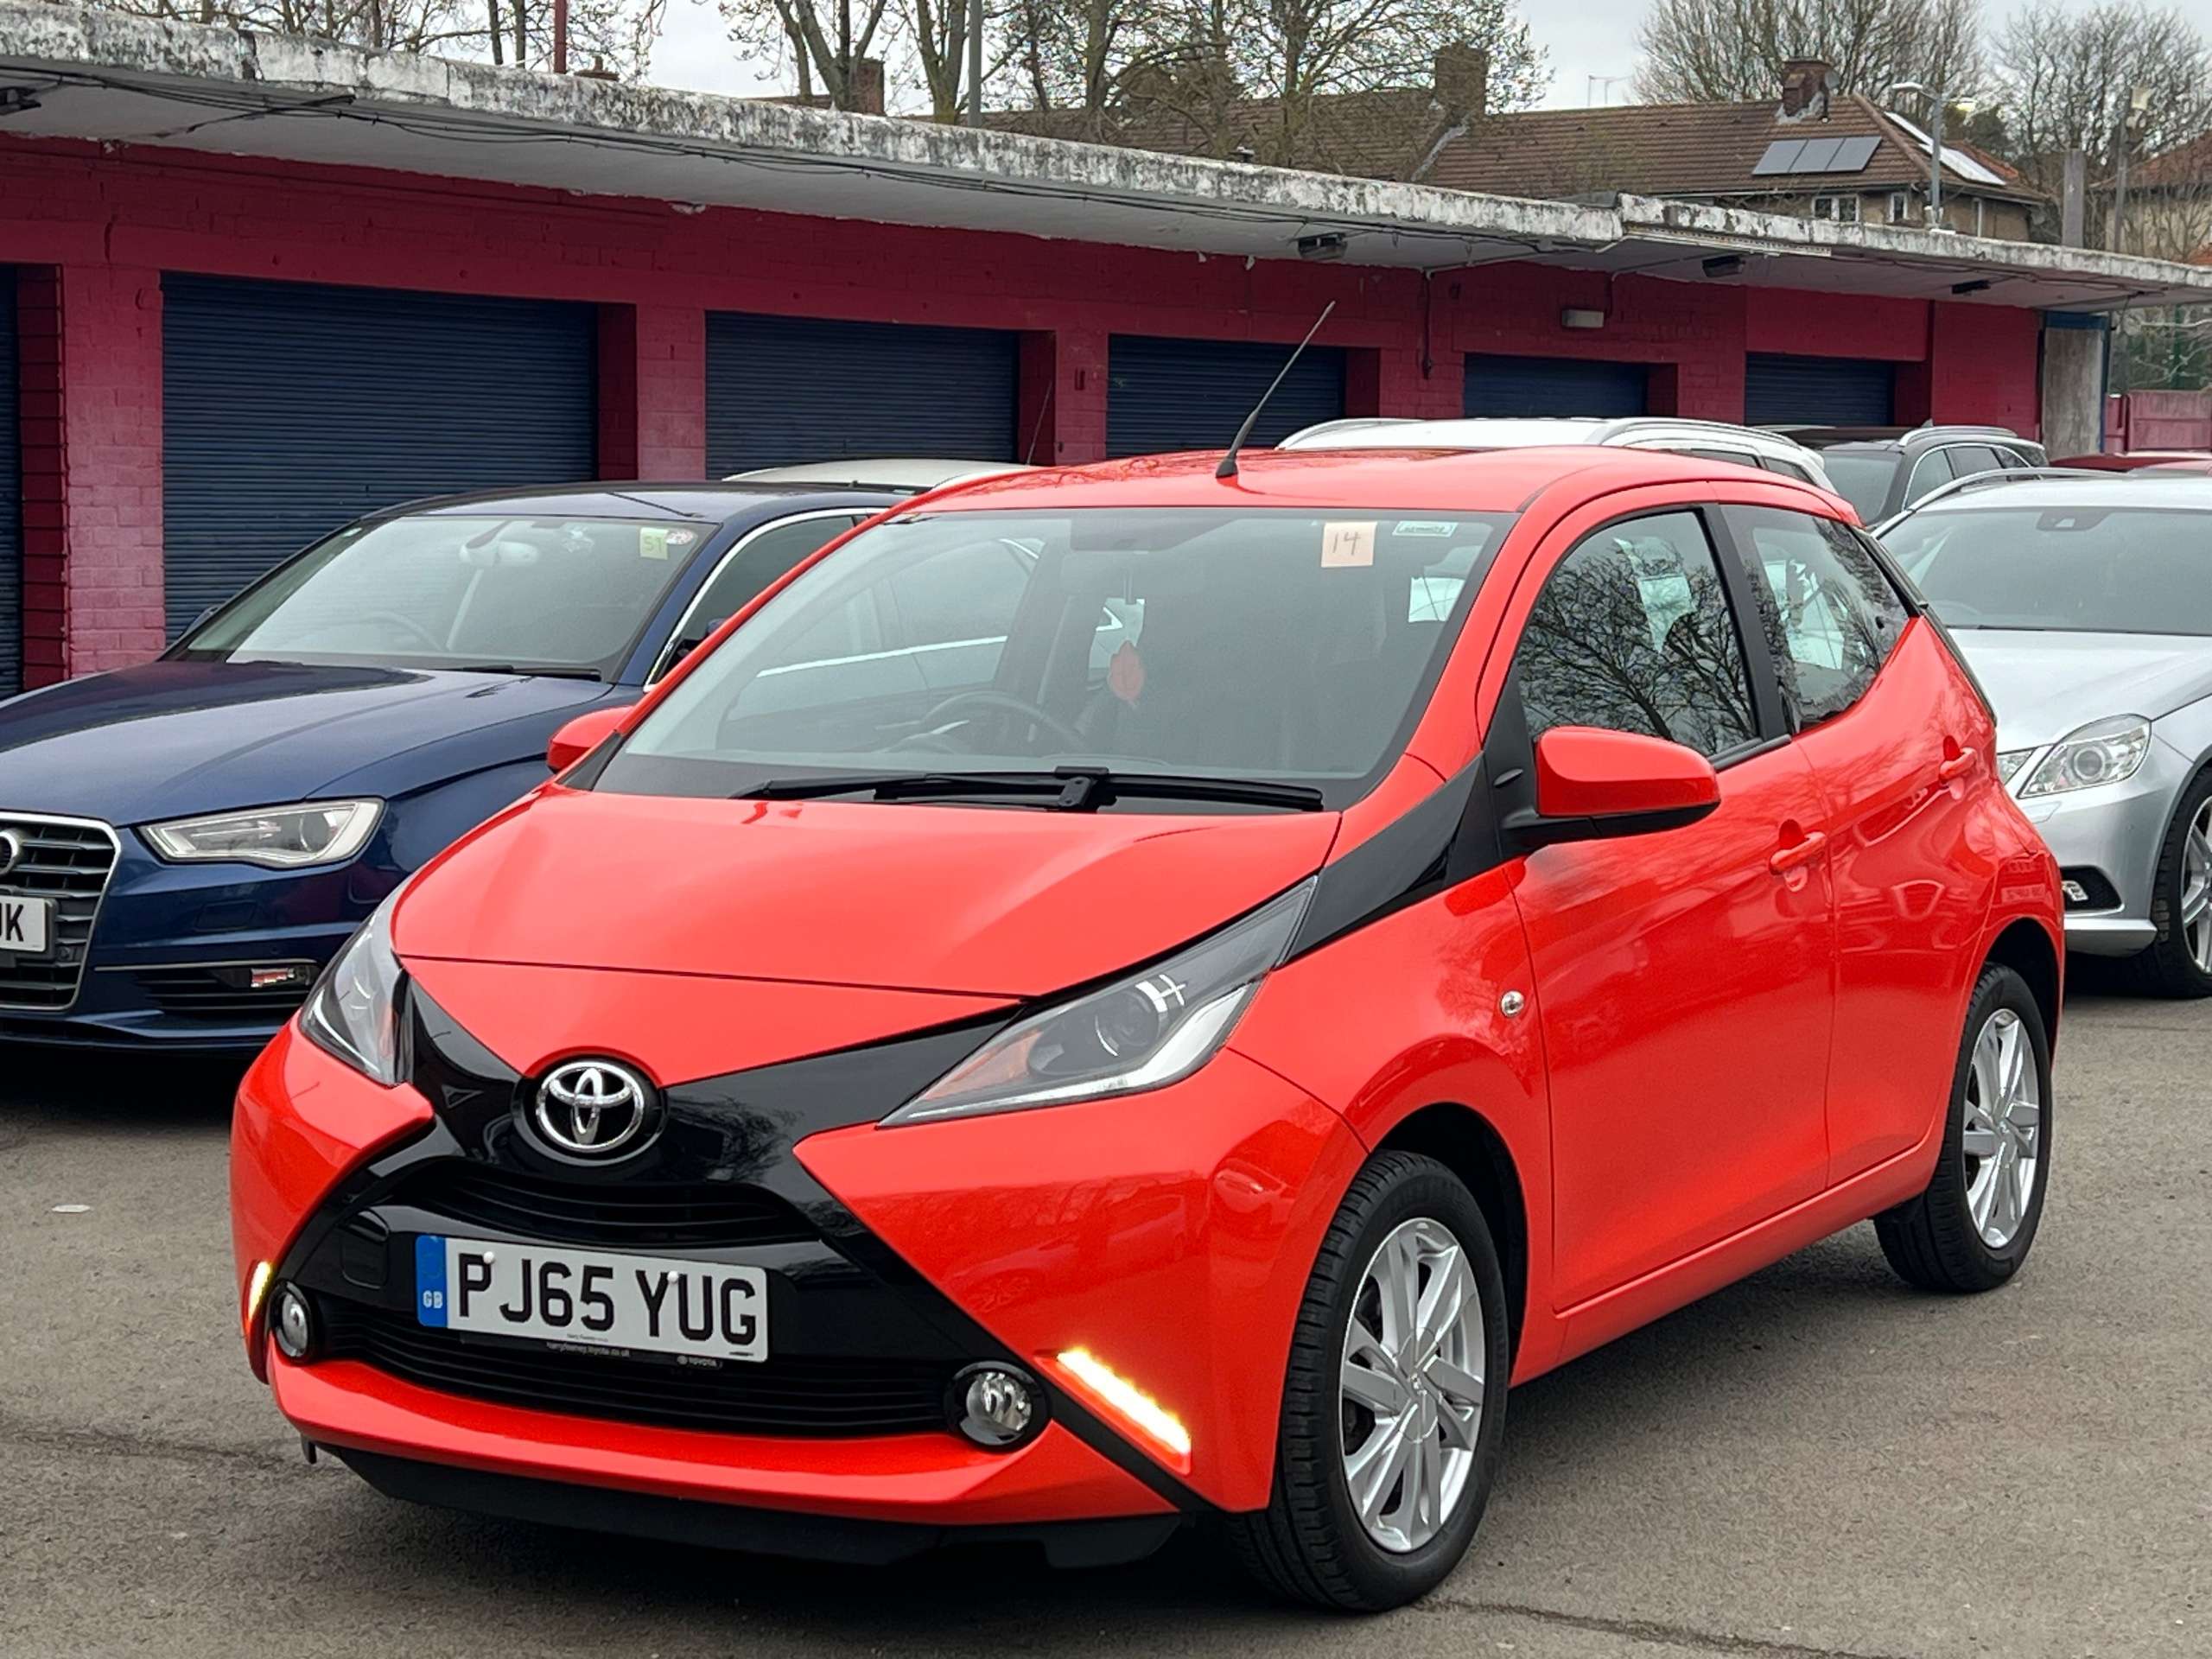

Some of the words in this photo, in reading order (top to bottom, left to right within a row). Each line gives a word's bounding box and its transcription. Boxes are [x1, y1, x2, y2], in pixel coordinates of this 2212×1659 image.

[1332, 531, 1362, 556] 14
[0, 903, 24, 943] K
[423, 1290, 443, 1309] GB
[458, 1252, 614, 1332] PJ65
[635, 1268, 757, 1346] YUG
